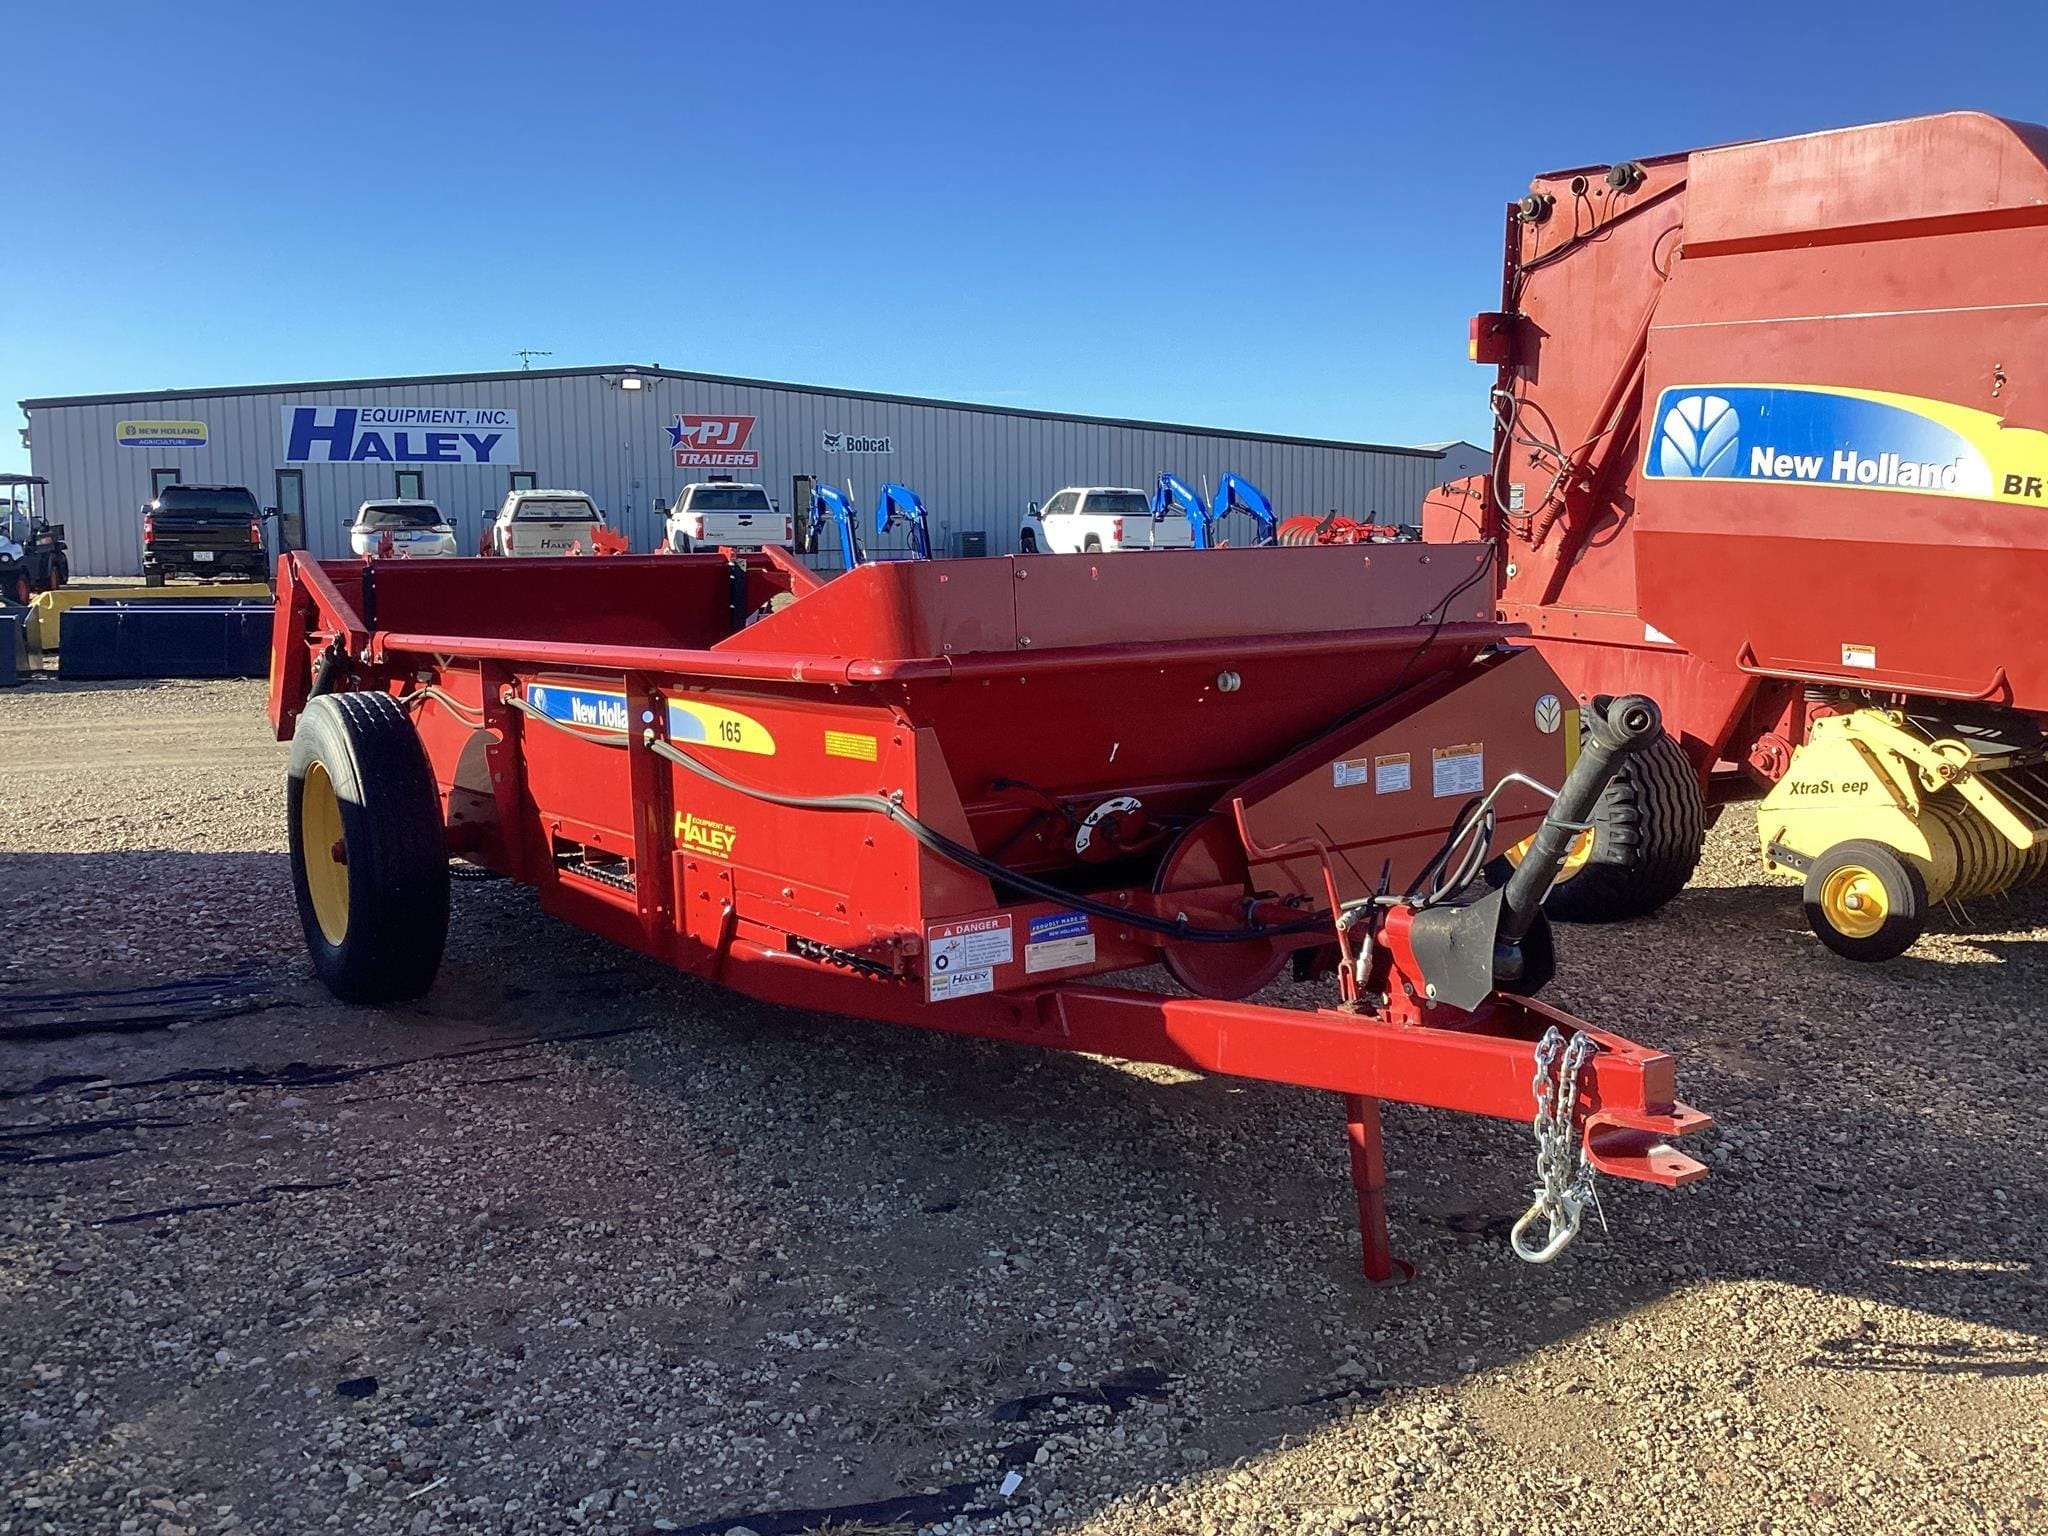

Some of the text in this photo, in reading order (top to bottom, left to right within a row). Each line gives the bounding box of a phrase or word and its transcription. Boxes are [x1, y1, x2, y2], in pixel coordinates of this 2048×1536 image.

[361, 408, 510, 426] EQUIPMENT, INC.
[138, 427, 200, 435] NEW HOLLAND
[286, 407, 503, 463] HALEY
[697, 421, 740, 445] PJ
[846, 437, 890, 452] Bobcat
[679, 453, 755, 465] TRAILERS
[1750, 446, 1965, 491] New Holland
[2003, 474, 2048, 498] BR
[571, 696, 629, 729] New Holla
[719, 719, 742, 743] 165
[674, 810, 737, 853] HALEY
[692, 816, 725, 830] EQUIPMENT
[956, 919, 999, 934] DANGER
[1032, 919, 1060, 932] PROUDLY
[1061, 916, 1078, 924] MADE
